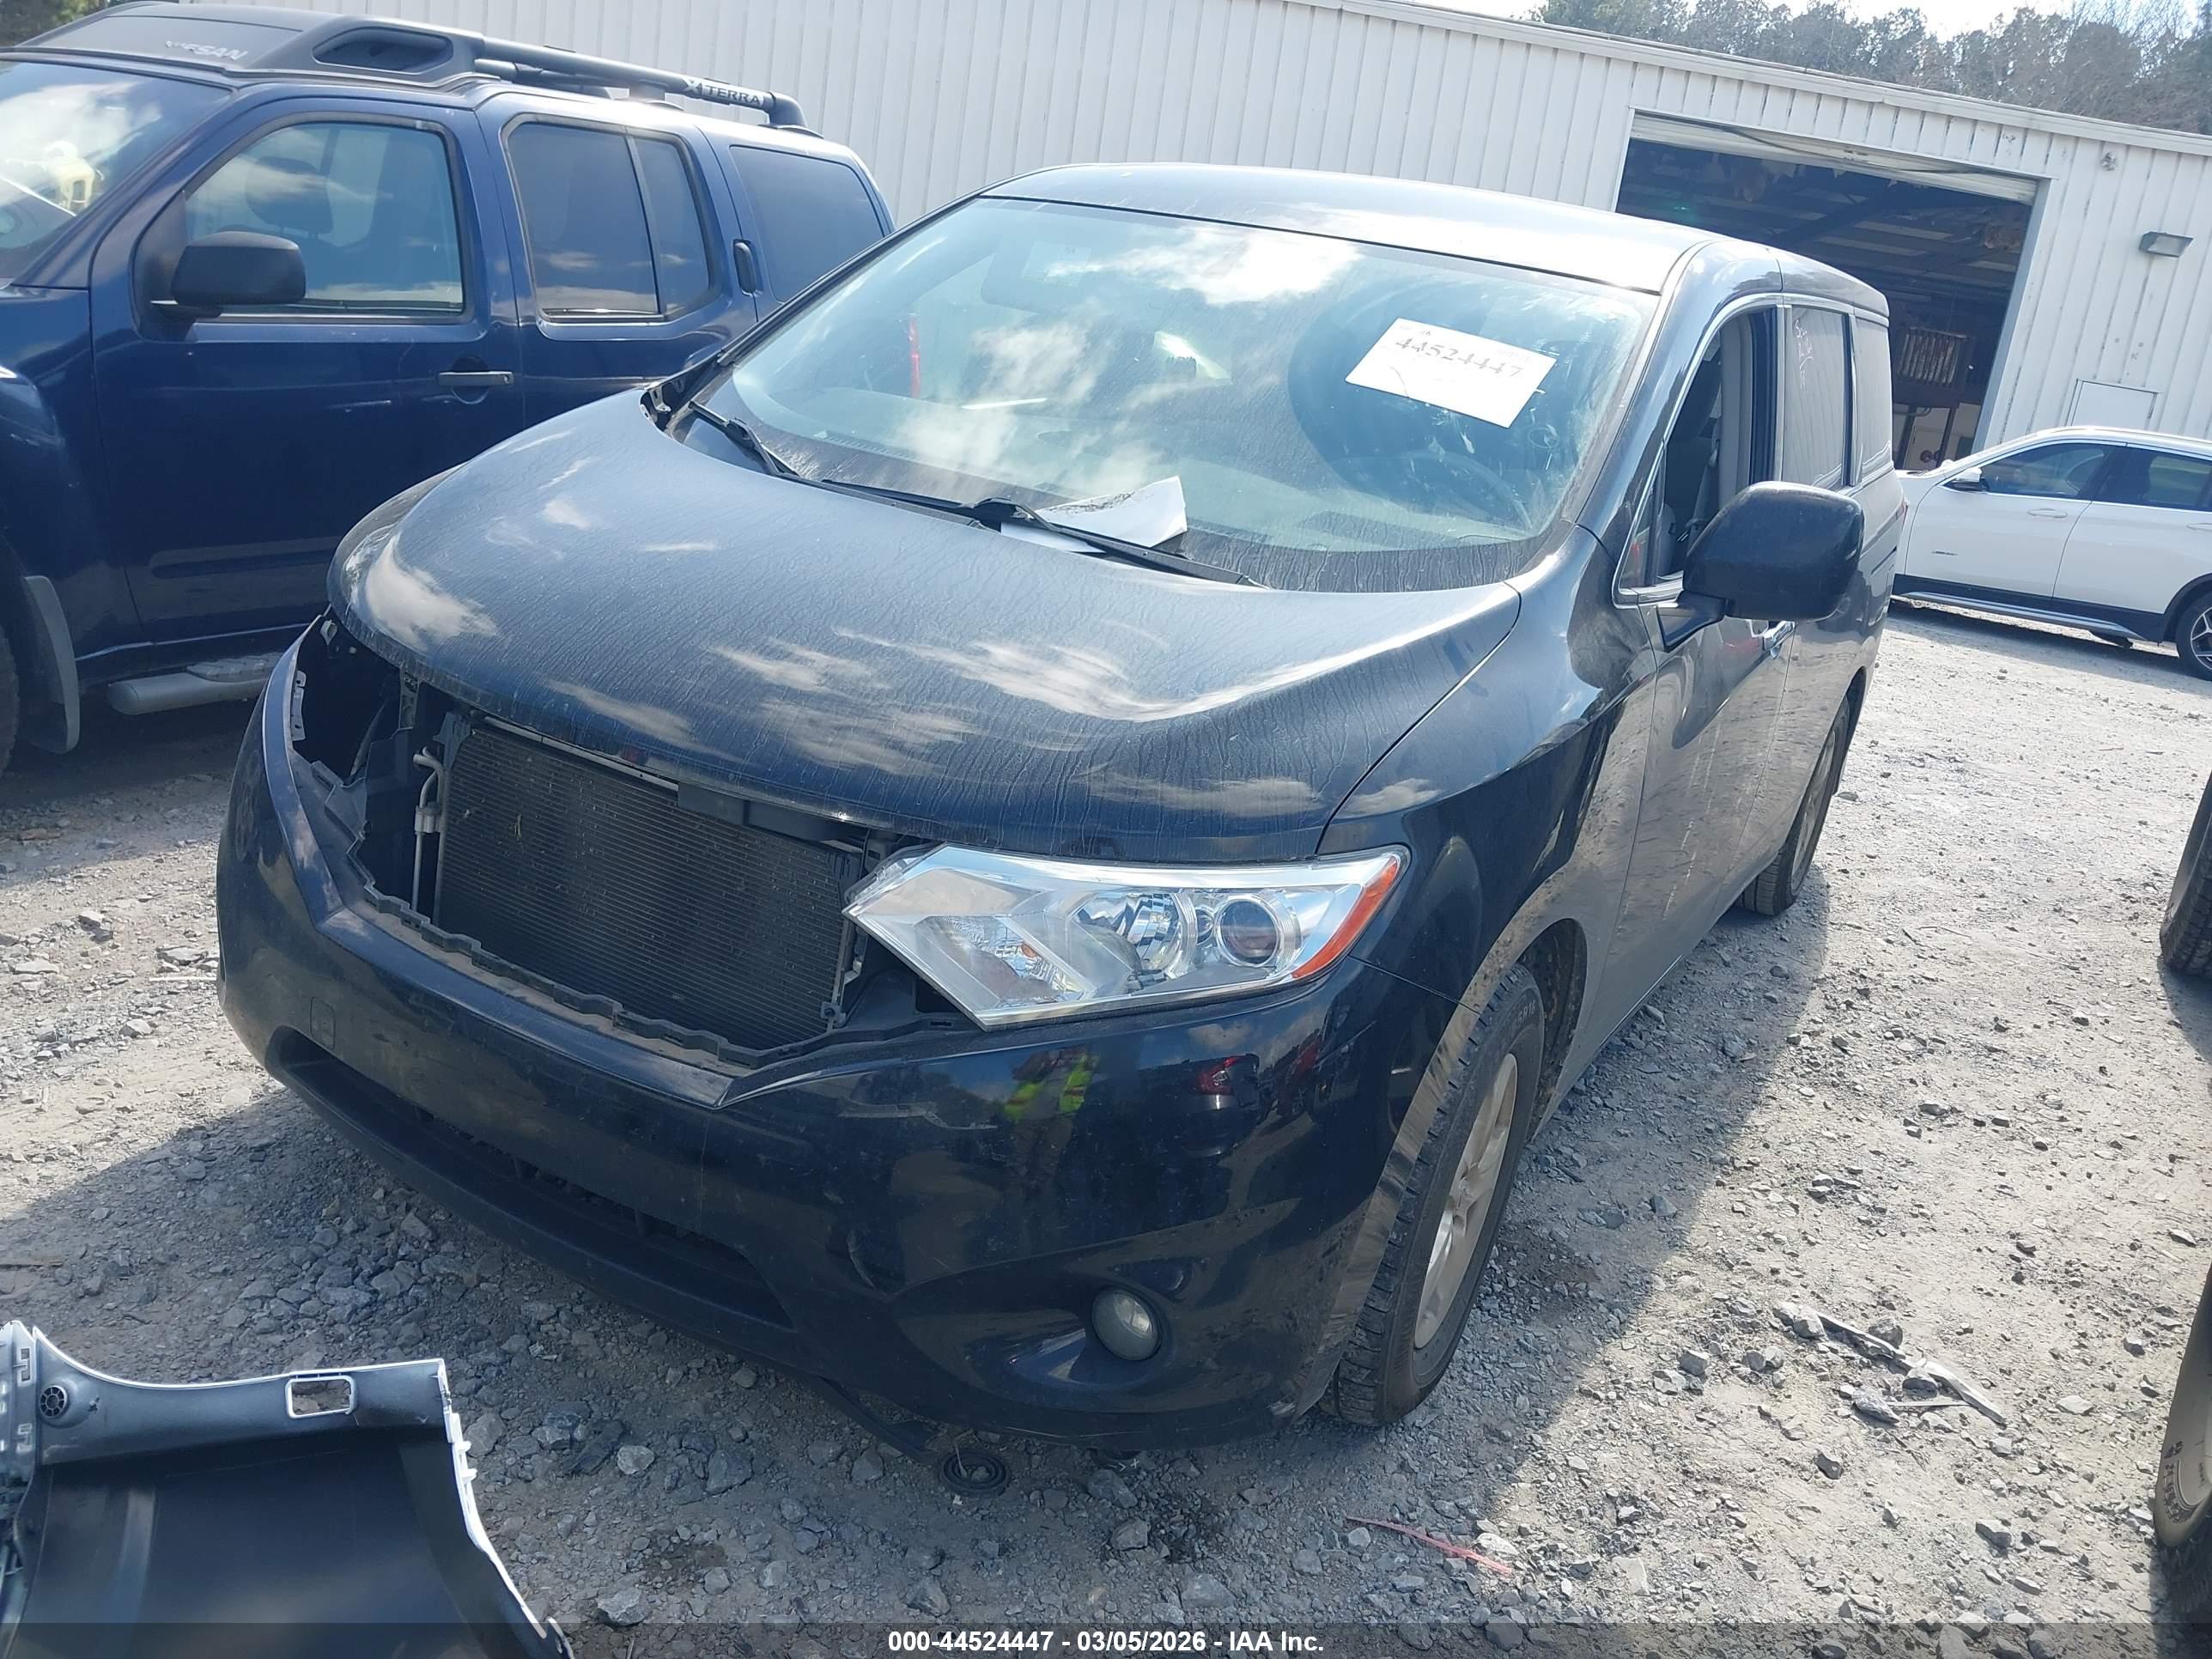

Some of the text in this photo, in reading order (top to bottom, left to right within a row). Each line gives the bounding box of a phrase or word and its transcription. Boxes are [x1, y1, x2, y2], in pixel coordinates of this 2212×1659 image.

[166, 40, 248, 61] SSAN
[686, 79, 762, 105] XTERRA
[1395, 337, 1523, 377] 44524447
